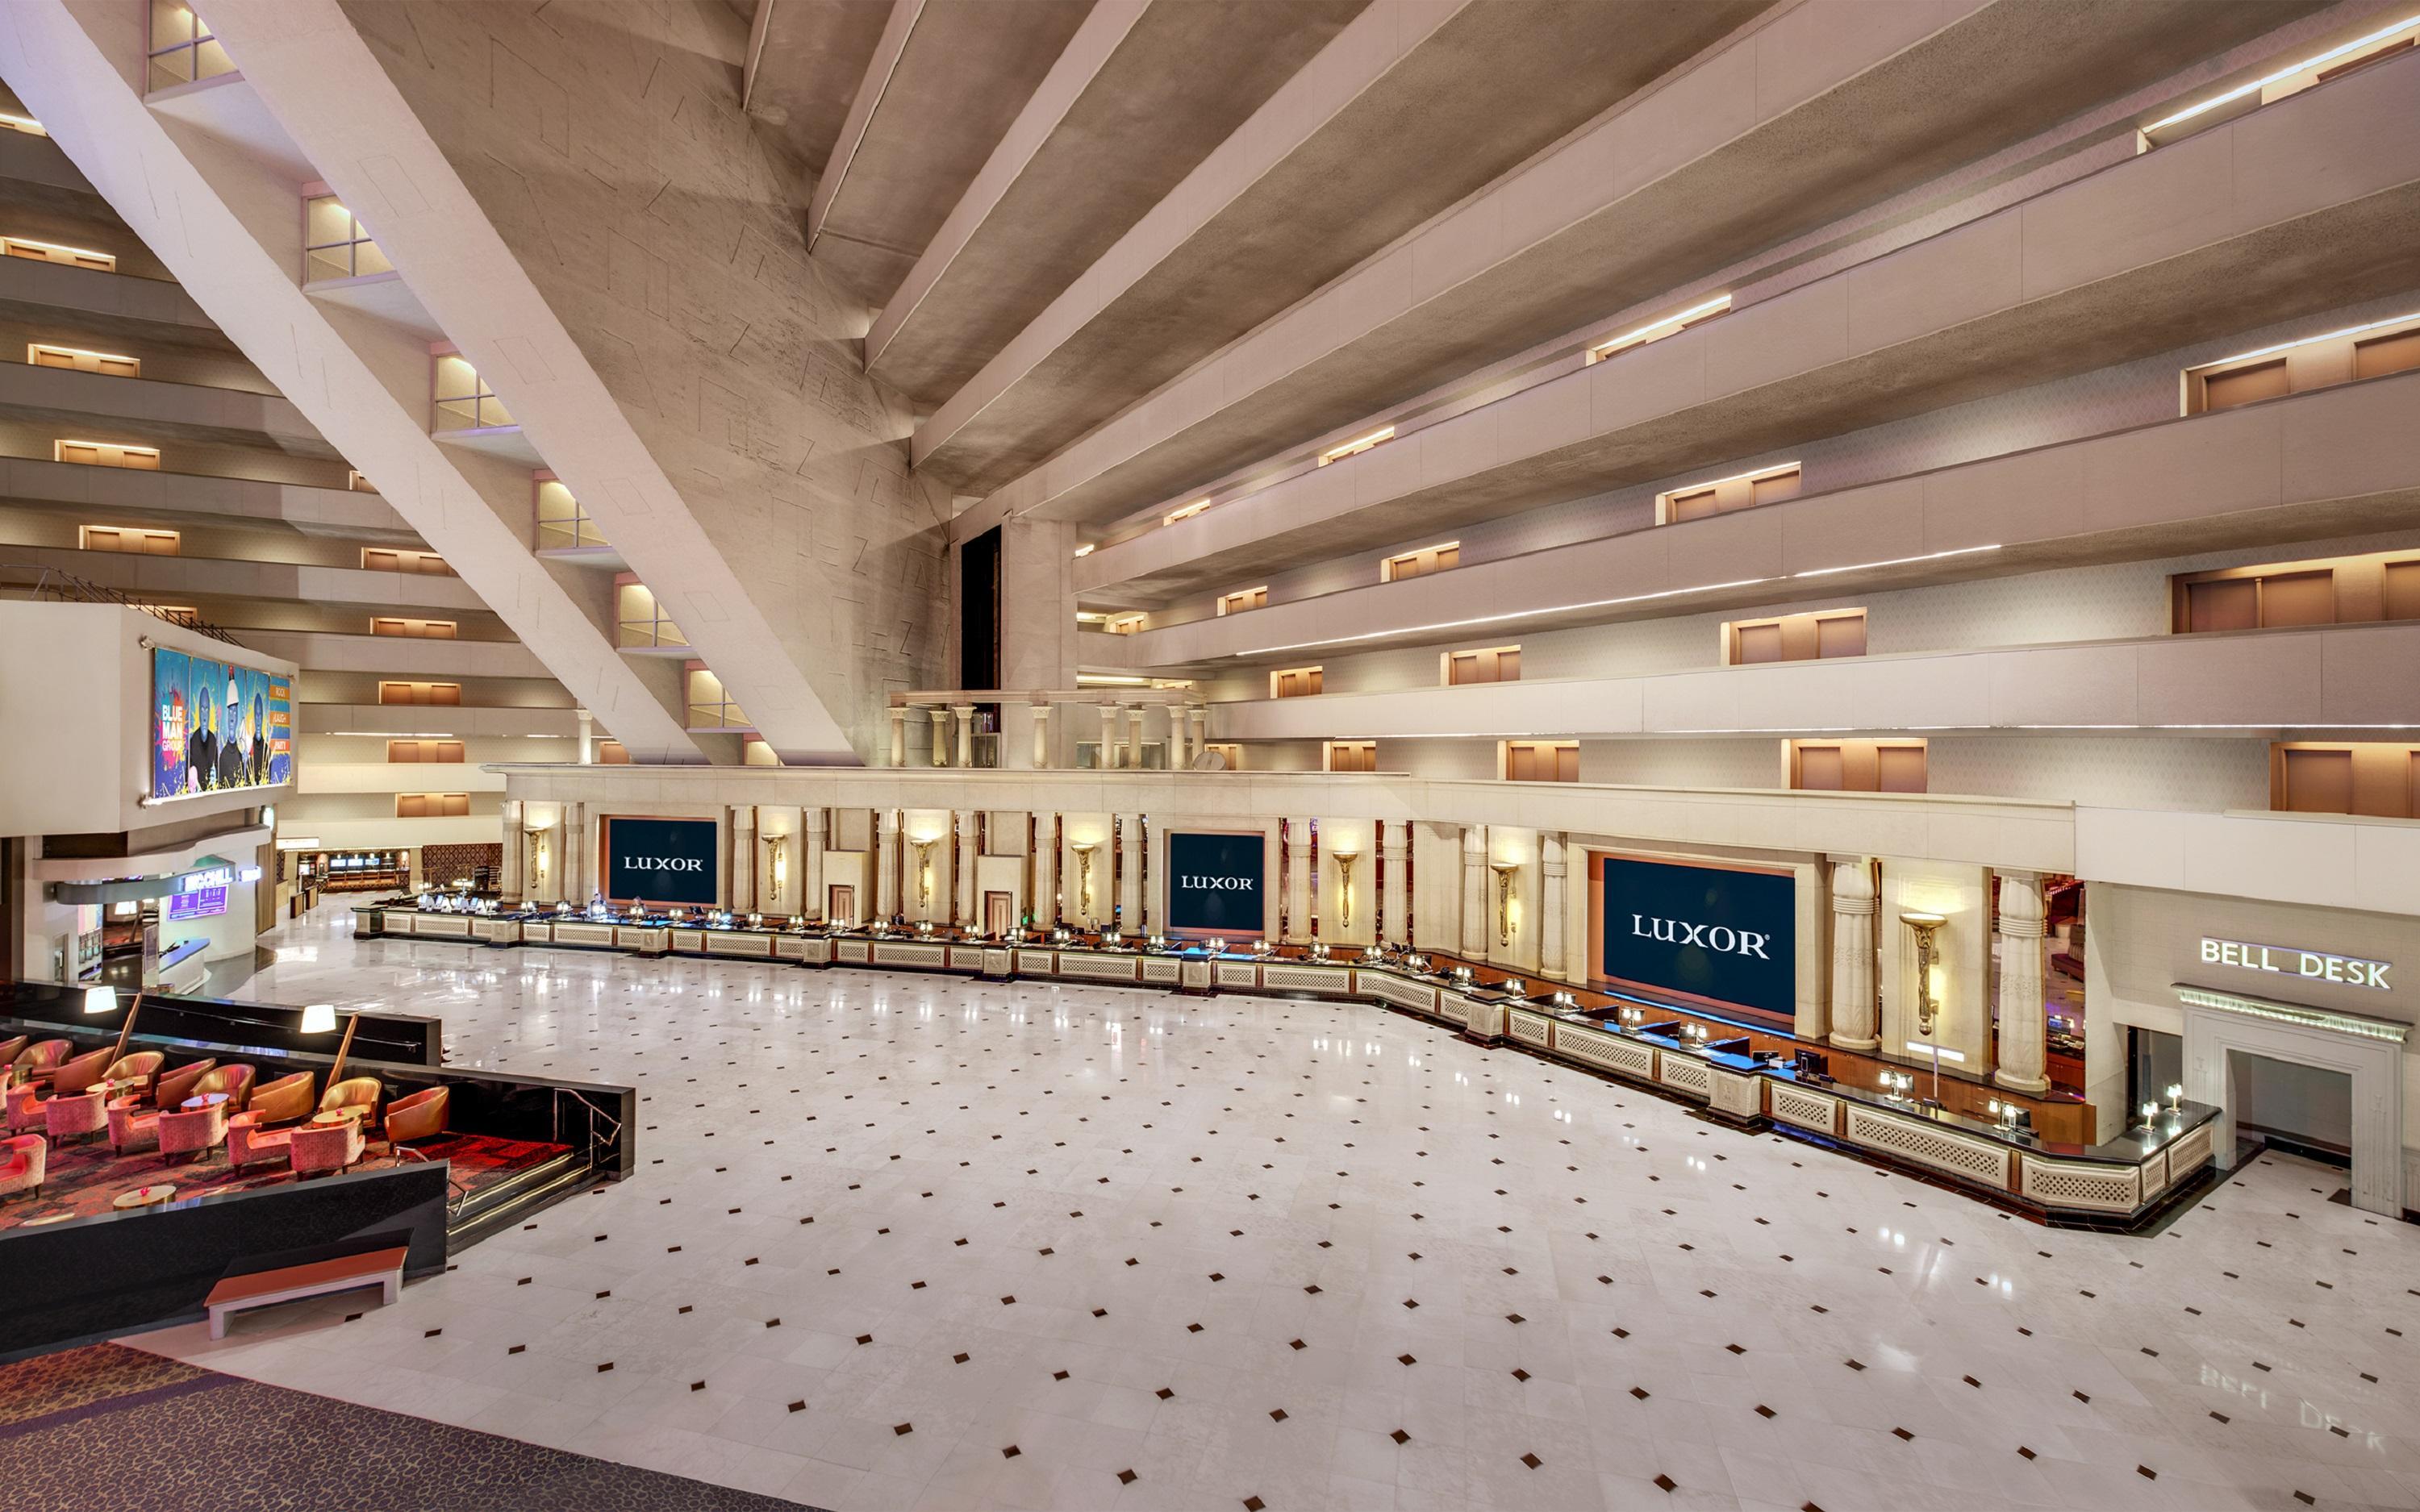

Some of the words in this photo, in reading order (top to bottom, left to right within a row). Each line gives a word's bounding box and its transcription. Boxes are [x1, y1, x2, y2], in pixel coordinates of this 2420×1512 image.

[162, 704, 183, 722] BLUE
[162, 721, 183, 739] MAN
[162, 739, 182, 752] GROUP
[624, 856, 703, 872] LUXOR
[1181, 875, 1254, 890] LUXOR
[1632, 914, 1771, 960] LUXOR
[2201, 939, 2280, 972] BELL
[2300, 952, 2391, 989] DESK
